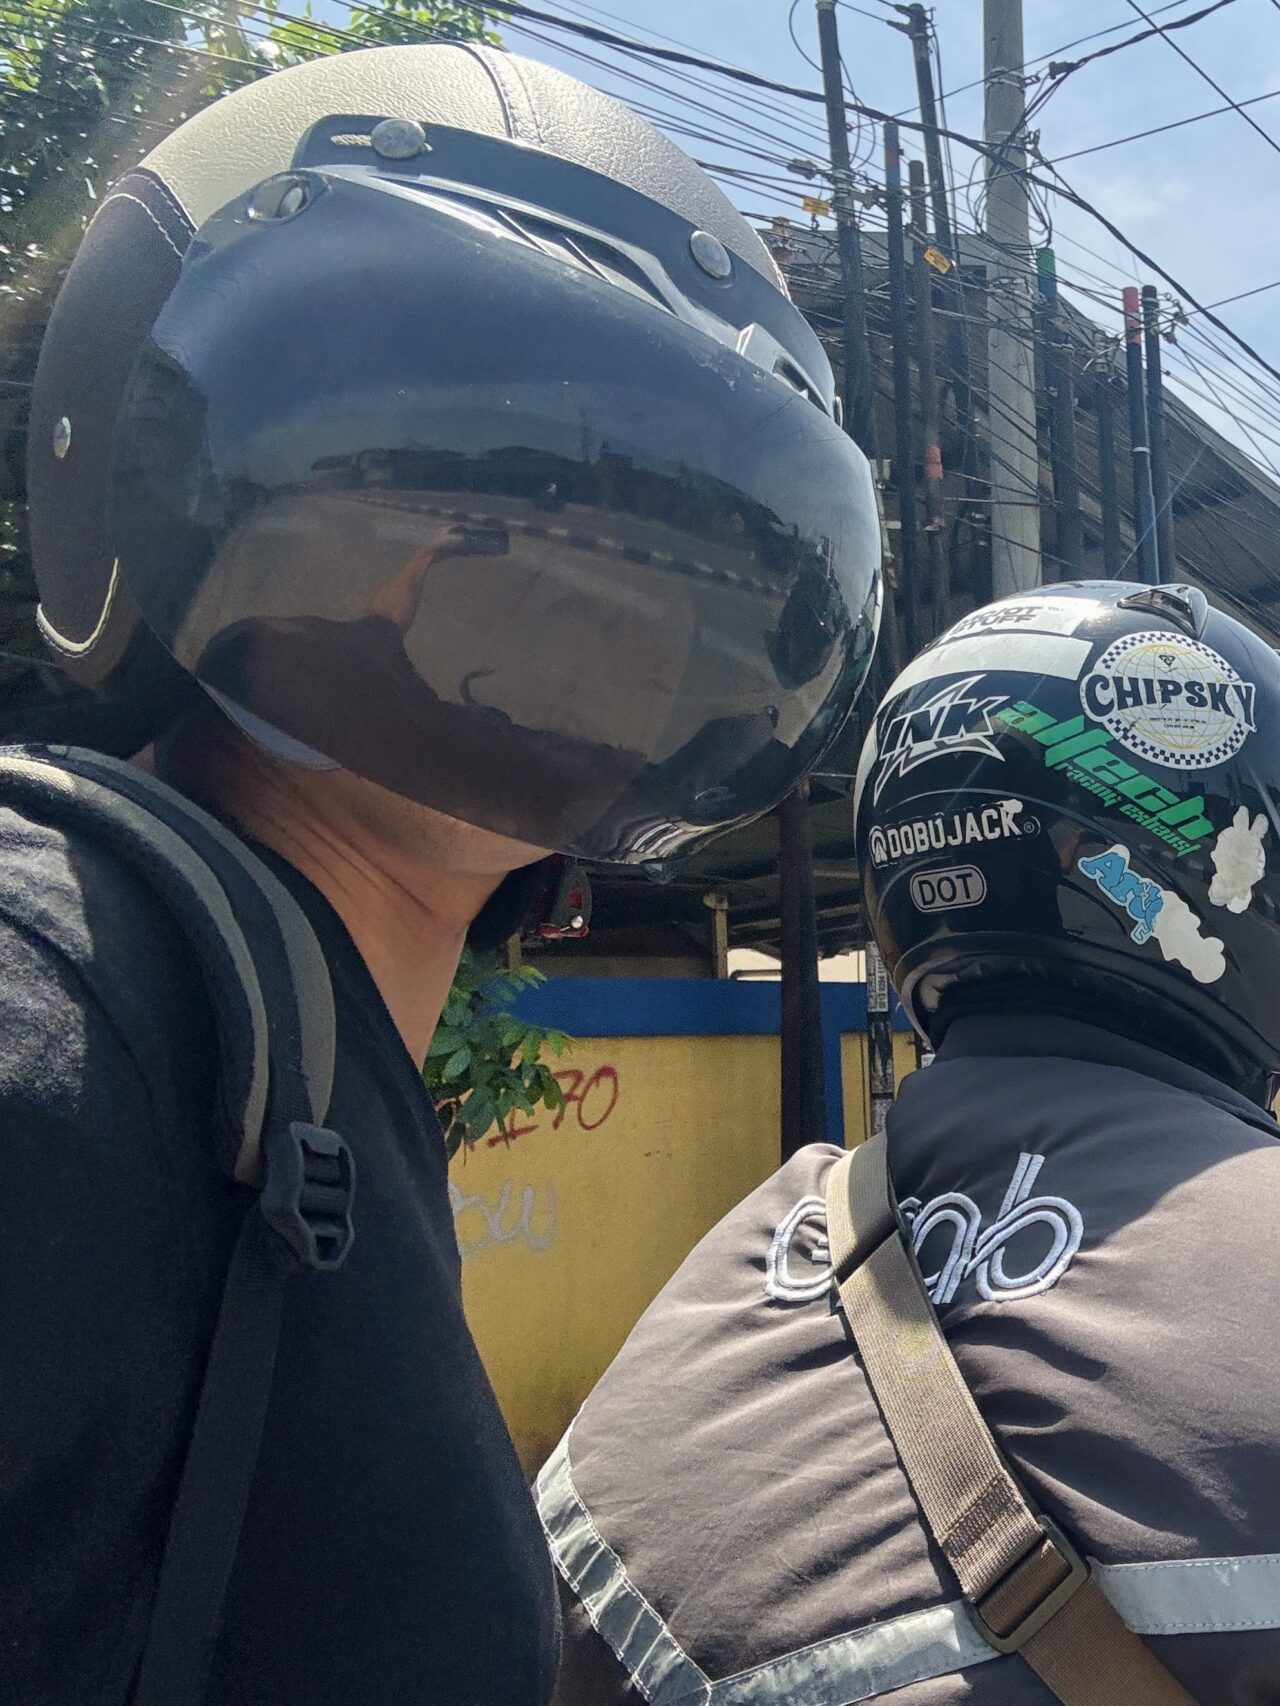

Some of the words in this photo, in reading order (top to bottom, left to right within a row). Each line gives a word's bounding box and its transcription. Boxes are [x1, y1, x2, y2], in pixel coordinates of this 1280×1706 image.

[876, 686, 1010, 778] INK
[1085, 674, 1254, 728] CHIPSKY
[886, 805, 1022, 860] DOBUJACK
[1053, 762, 1122, 808] racing
[1119, 803, 1202, 857] exhaust
[917, 872, 973, 906] DOT
[762, 1152, 1086, 1305] Gab
